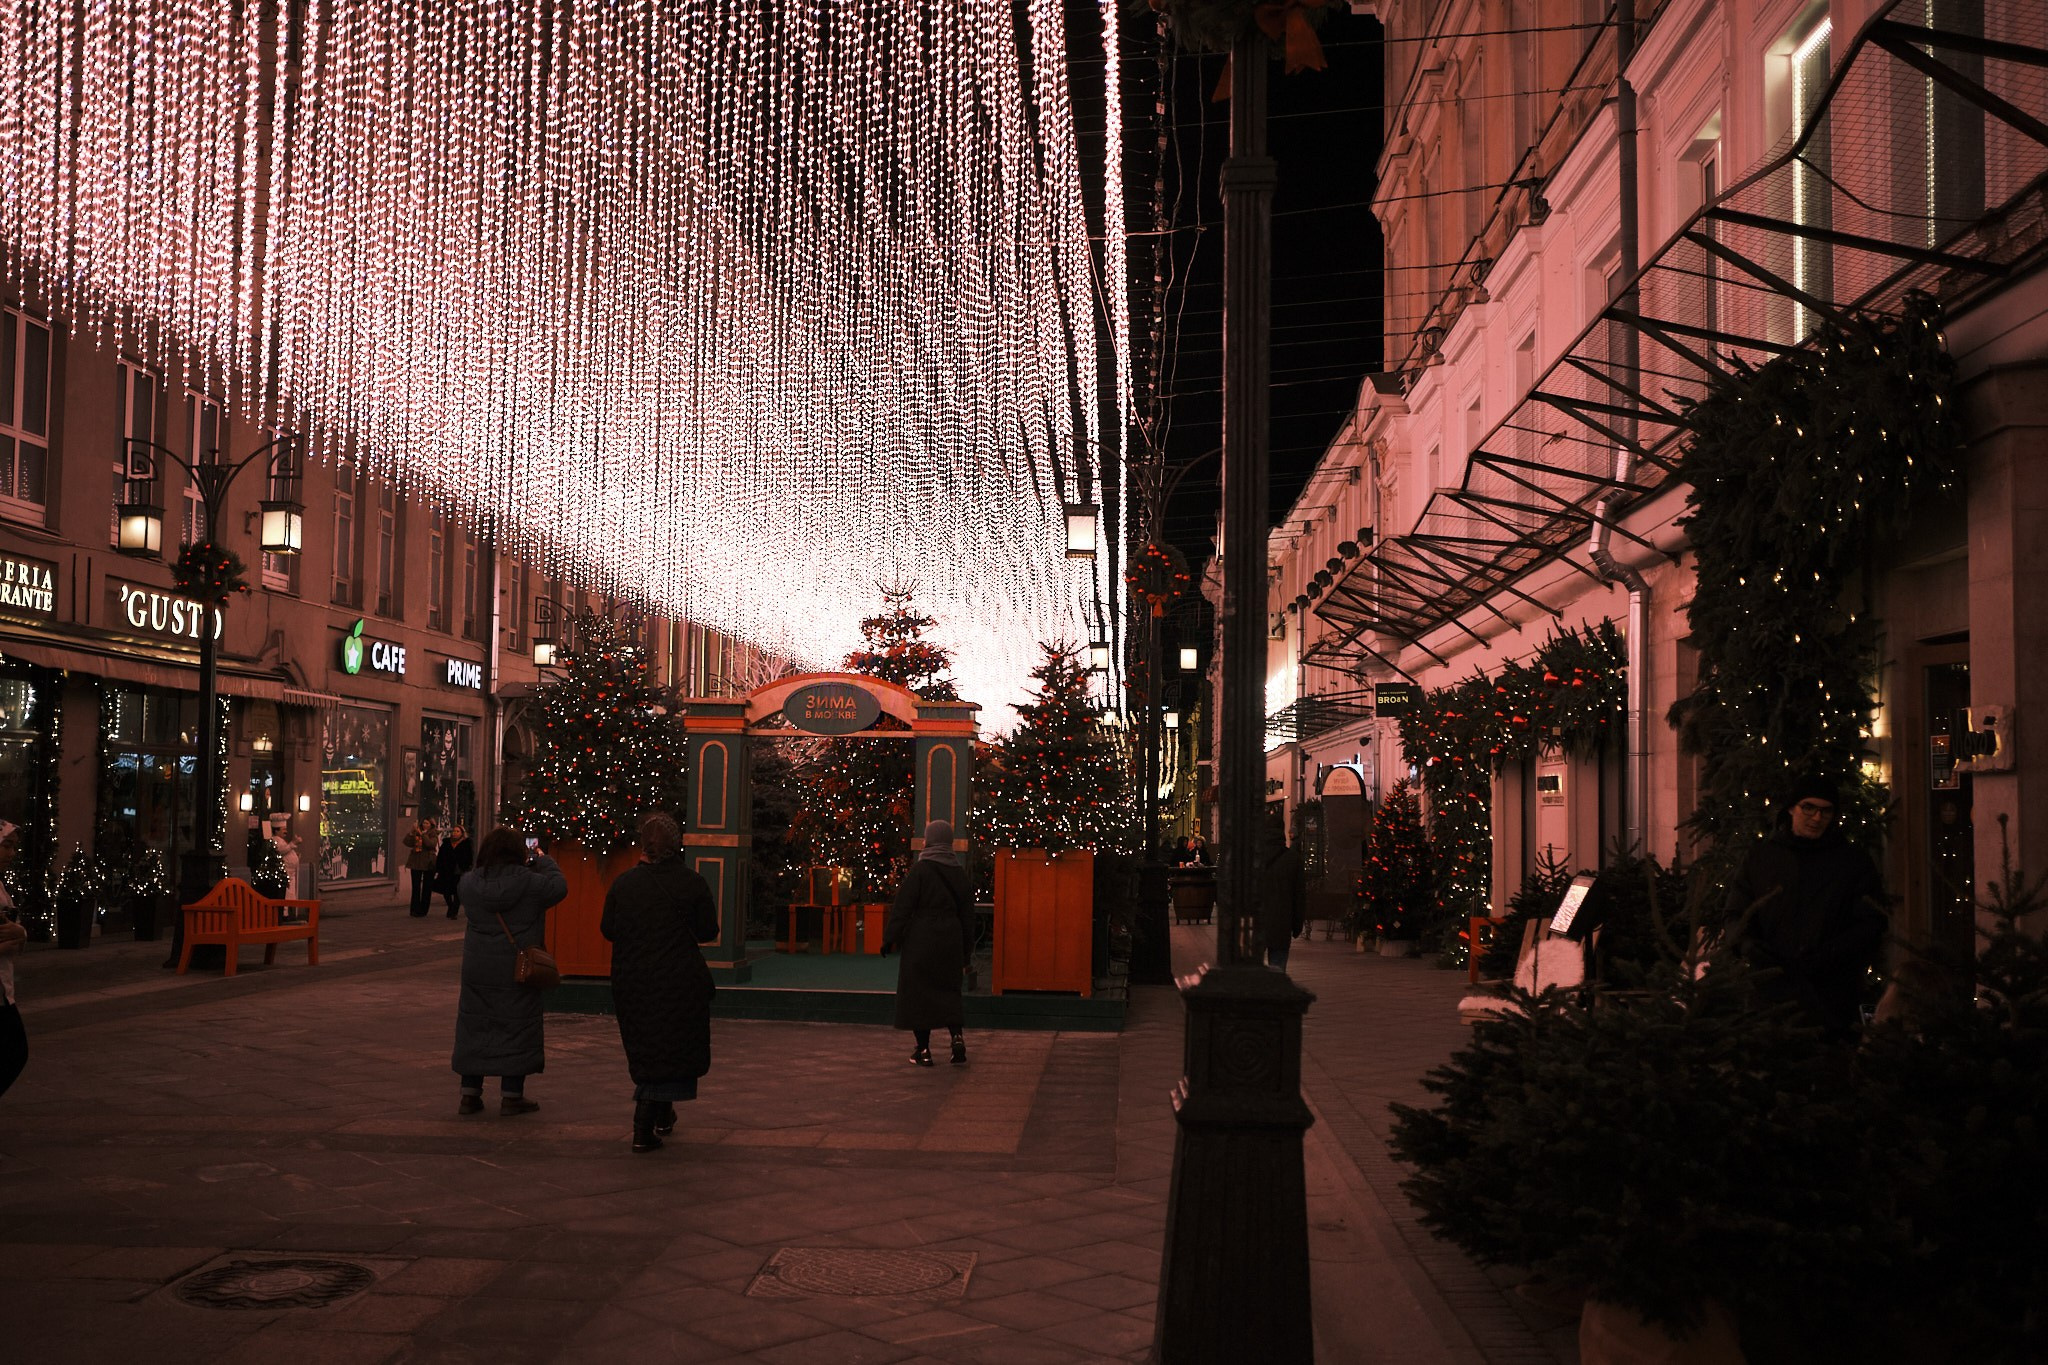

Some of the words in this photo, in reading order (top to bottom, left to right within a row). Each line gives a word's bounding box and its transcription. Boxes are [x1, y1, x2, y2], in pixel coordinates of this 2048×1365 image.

[0, 560, 52, 590] ERIA
[0, 583, 52, 611] RANTE
[371, 641, 406, 674] CAFE
[447, 659, 482, 689] PRIME
[805, 711, 812, 719] В
[814, 711, 857, 720] МОКВЕ
[806, 695, 857, 709] ЗИМА
